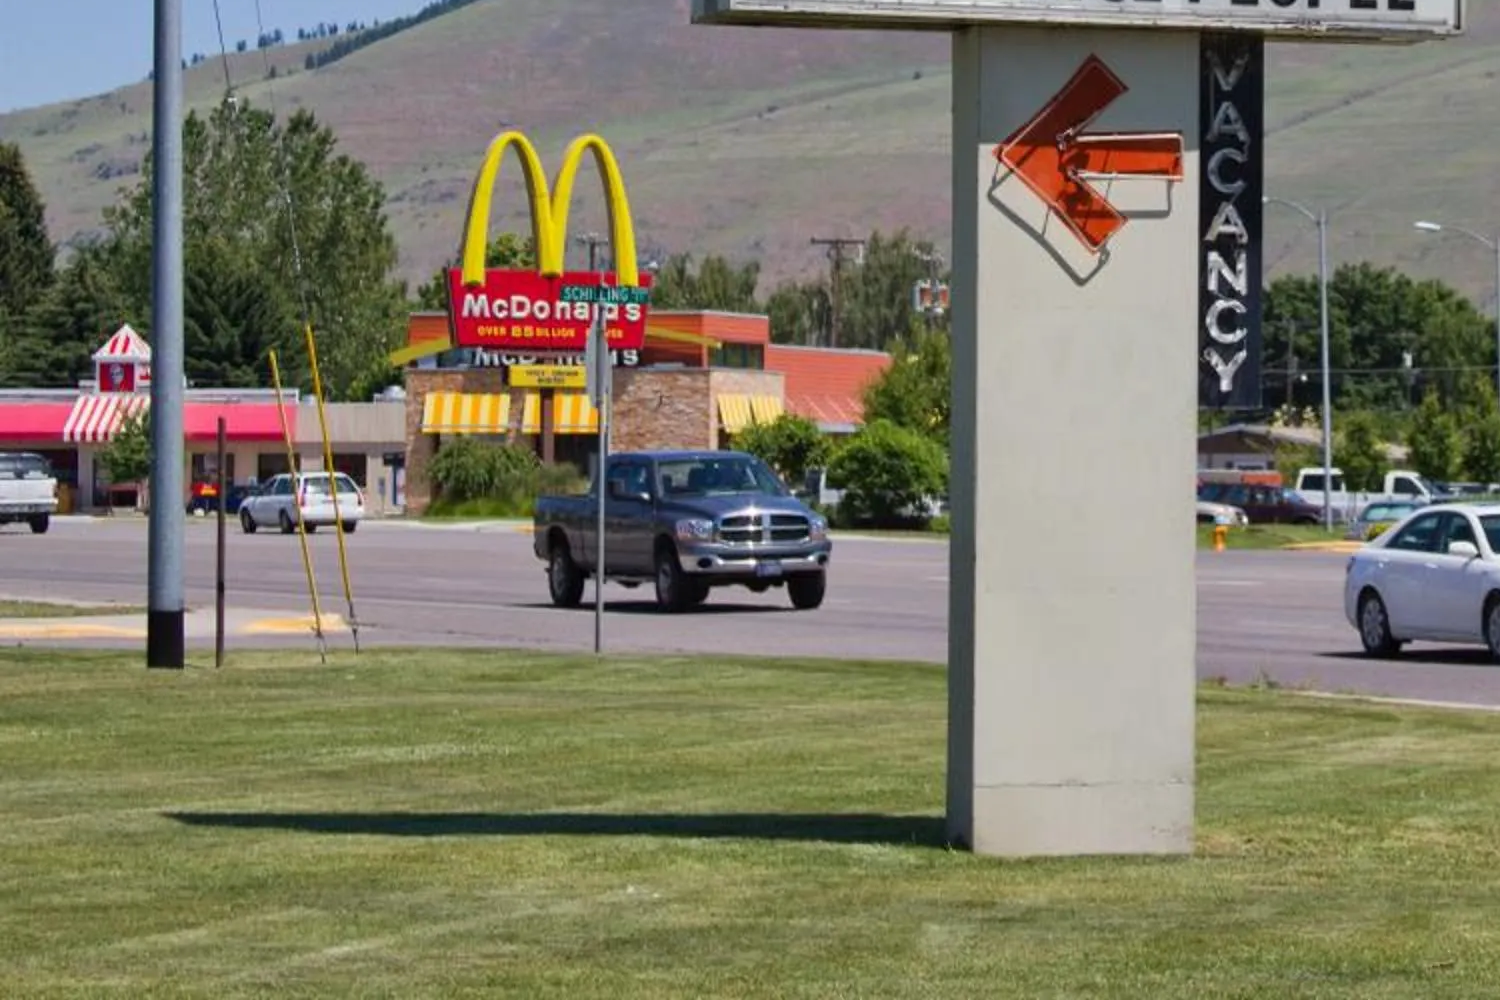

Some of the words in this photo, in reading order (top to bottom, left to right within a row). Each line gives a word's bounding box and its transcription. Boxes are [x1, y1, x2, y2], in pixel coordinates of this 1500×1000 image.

[1202, 50, 1250, 393] VACANCY
[462, 293, 641, 321] McDonalds
[477, 325, 506, 337] OVER
